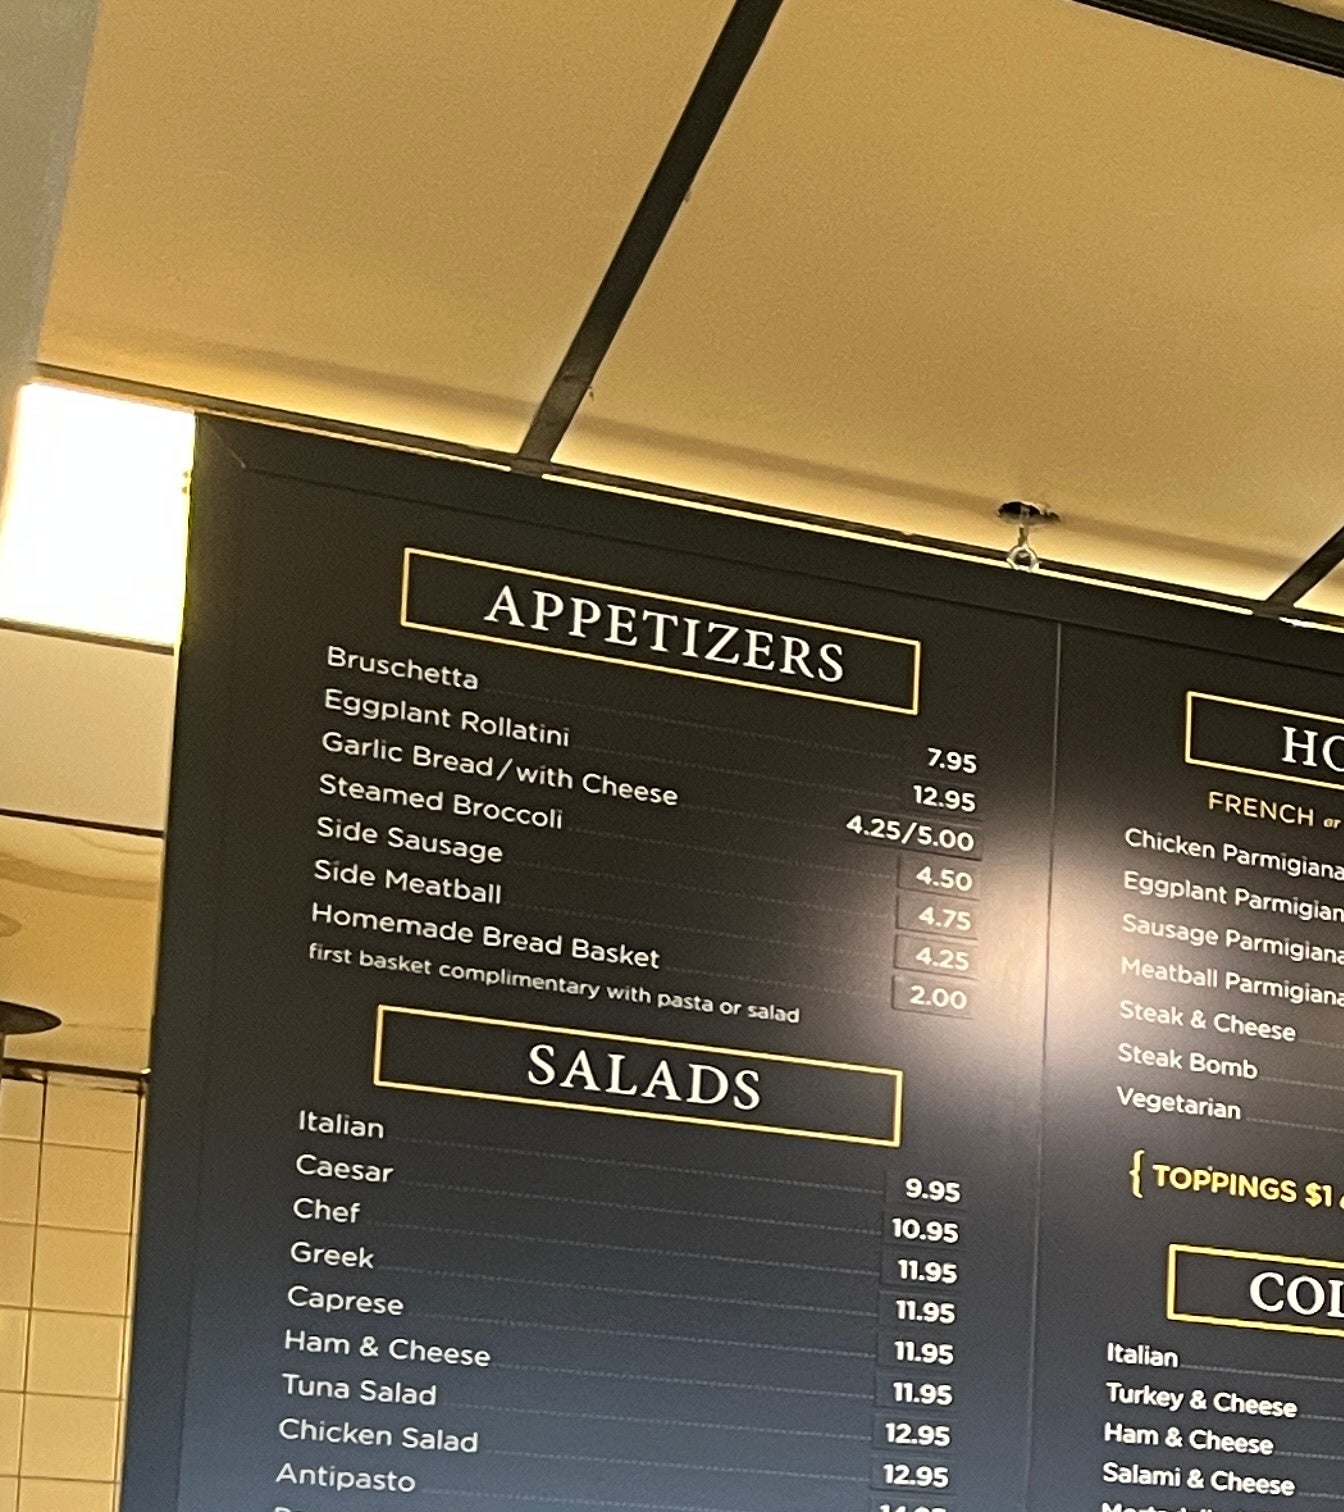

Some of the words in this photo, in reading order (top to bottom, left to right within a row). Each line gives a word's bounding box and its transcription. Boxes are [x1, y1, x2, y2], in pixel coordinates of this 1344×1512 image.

[484, 586, 842, 682] APPETIZERS
[328, 646, 478, 689] Bruschetta
[928, 748, 976, 773] 7.95
[325, 689, 451, 728] Eggplant
[462, 711, 568, 746] Rollatini
[914, 785, 975, 811] 12.95
[320, 774, 443, 810] Steamed
[454, 794, 562, 829] Broccoli
[916, 866, 972, 891] 4.50
[1126, 828, 1215, 858] Chicken
[1209, 792, 1313, 826] FRENCH
[1324, 818, 1341, 828] or
[310, 943, 352, 964] first
[360, 950, 432, 974] basket
[439, 965, 600, 999] complimentary
[607, 987, 651, 1003] with
[658, 994, 713, 1012] pasta
[720, 1002, 742, 1014] or
[748, 1005, 799, 1023] salad
[528, 1045, 759, 1110] SALADS
[1119, 1043, 1183, 1069] Steak
[1190, 1053, 1258, 1079] Bomb
[1117, 1087, 1240, 1119] Vegetarian
[300, 1111, 383, 1138] Italian
[906, 1179, 960, 1202] 9.95
[1152, 1165, 1296, 1202] TOPPINGS
[1305, 1183, 1331, 1207] $1
[297, 1154, 393, 1182] Caesar
[893, 1218, 958, 1243] 10.95
[293, 1198, 360, 1223] Chef
[898, 1260, 957, 1283] 11.95
[1108, 1343, 1178, 1367] Italian
[1106, 1382, 1184, 1411] Turkey
[1190, 1390, 1207, 1409] &
[1213, 1393, 1297, 1417] Cheese
